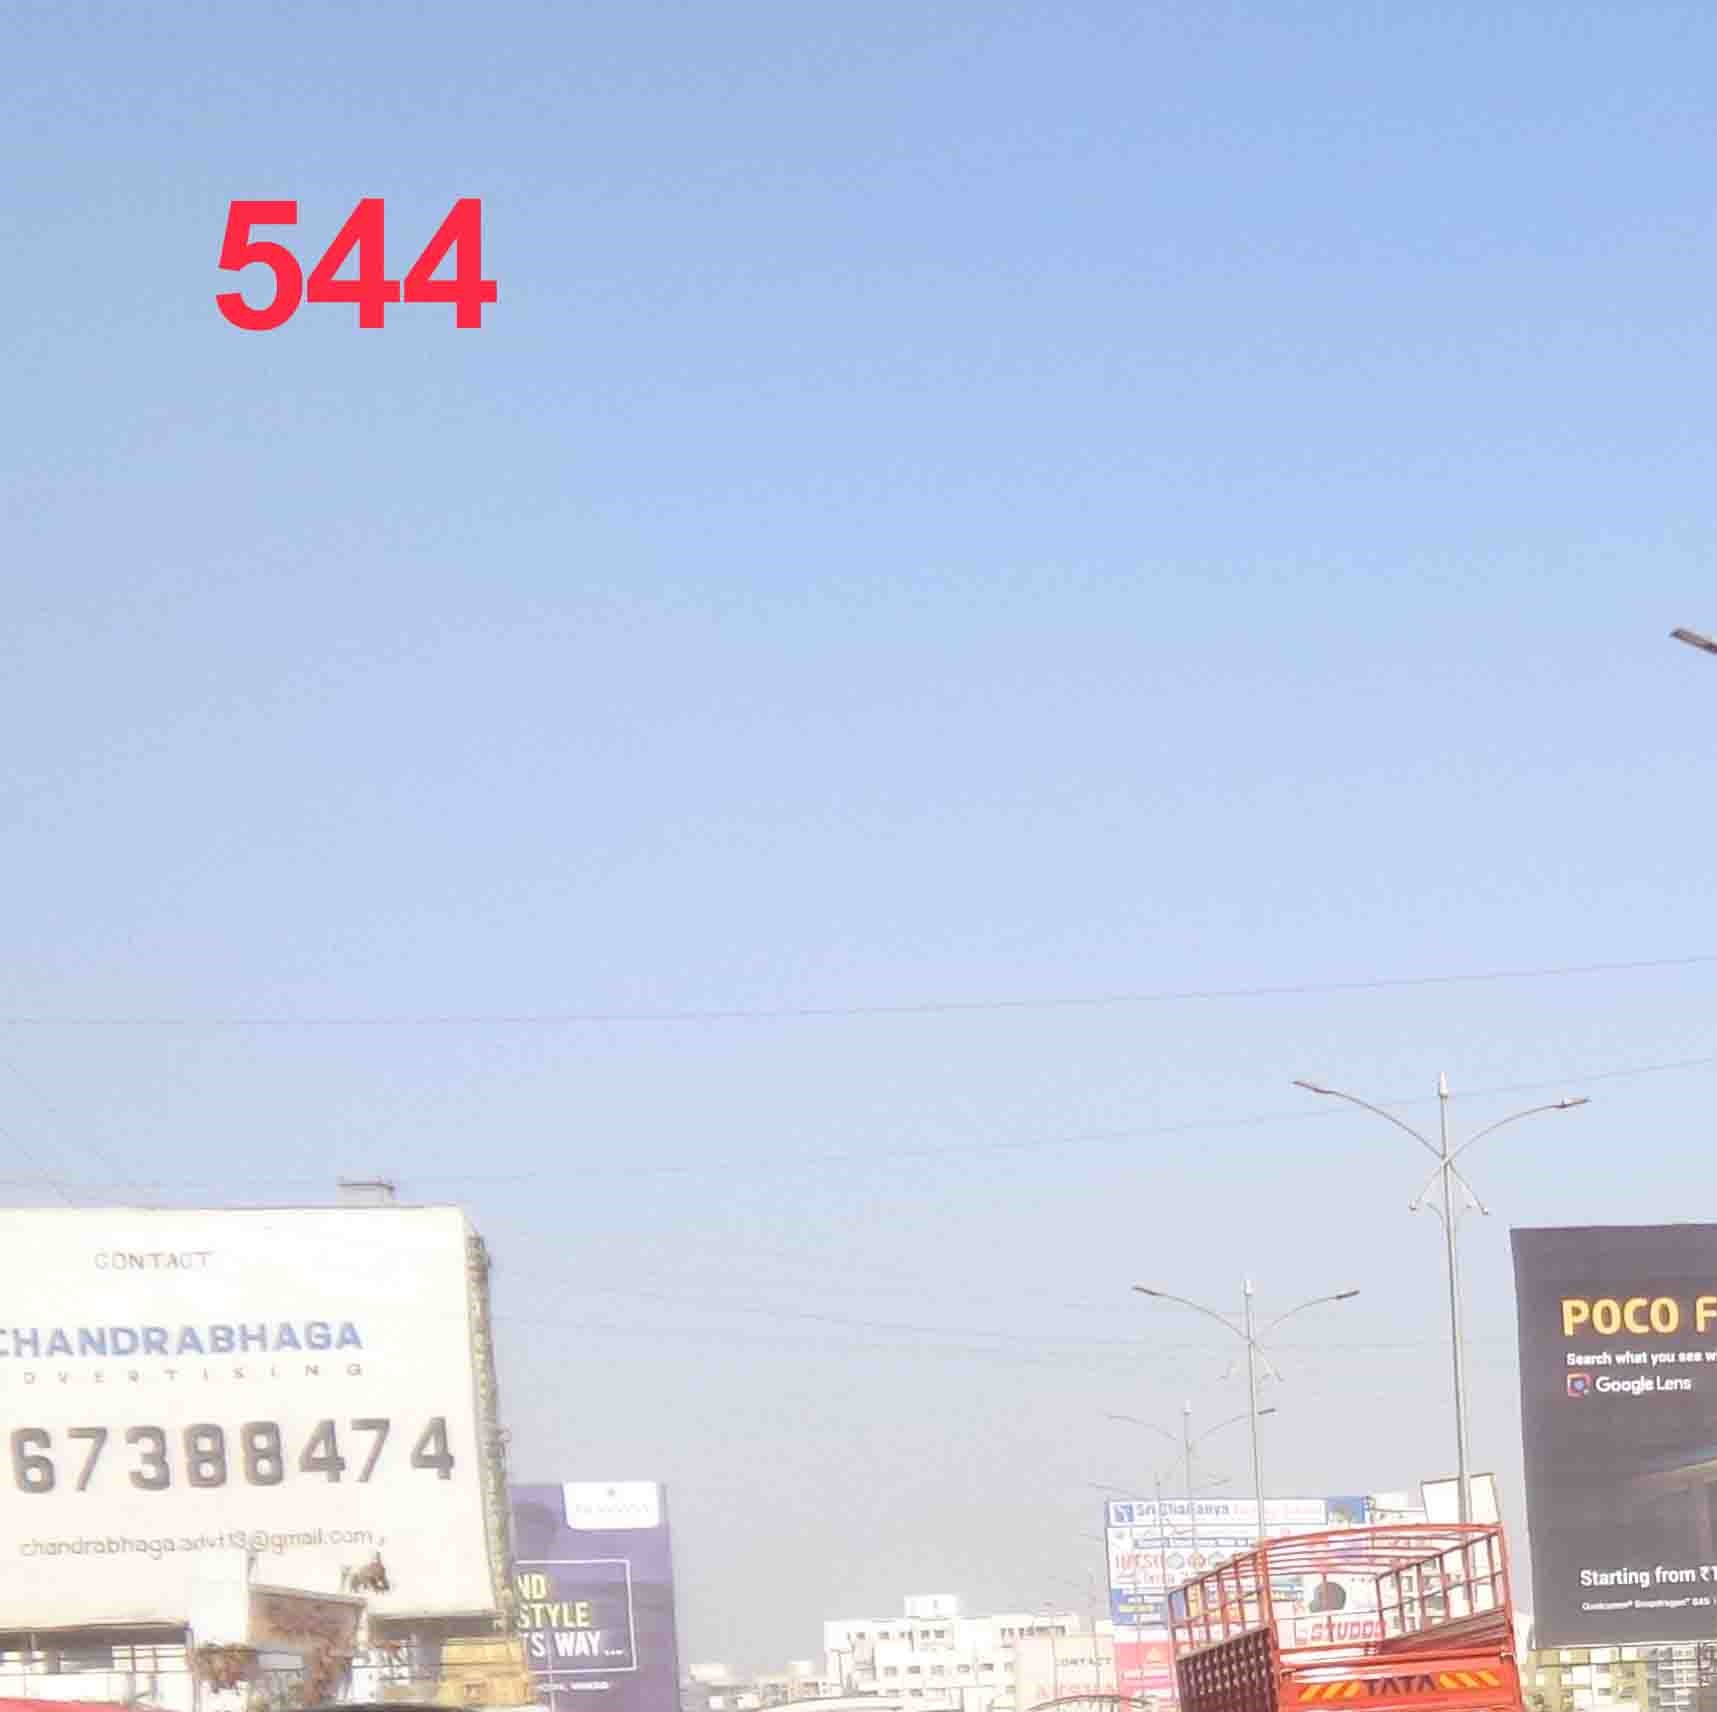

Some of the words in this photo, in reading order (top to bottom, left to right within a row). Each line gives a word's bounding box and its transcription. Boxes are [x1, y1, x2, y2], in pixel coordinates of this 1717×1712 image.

[94, 1251, 214, 1270] CONTACT
[1561, 1297, 1681, 1337] POCO
[1566, 1351, 1612, 1367] Search
[1615, 1350, 1648, 1366] what
[1650, 1352, 1676, 1369] you
[1595, 1376, 1655, 1396] Google
[1656, 1375, 1692, 1392] Lens
[1580, 1567, 1650, 1588] Starting
[1655, 1564, 1696, 1584] from
[1362, 1673, 1437, 1697] TATA
